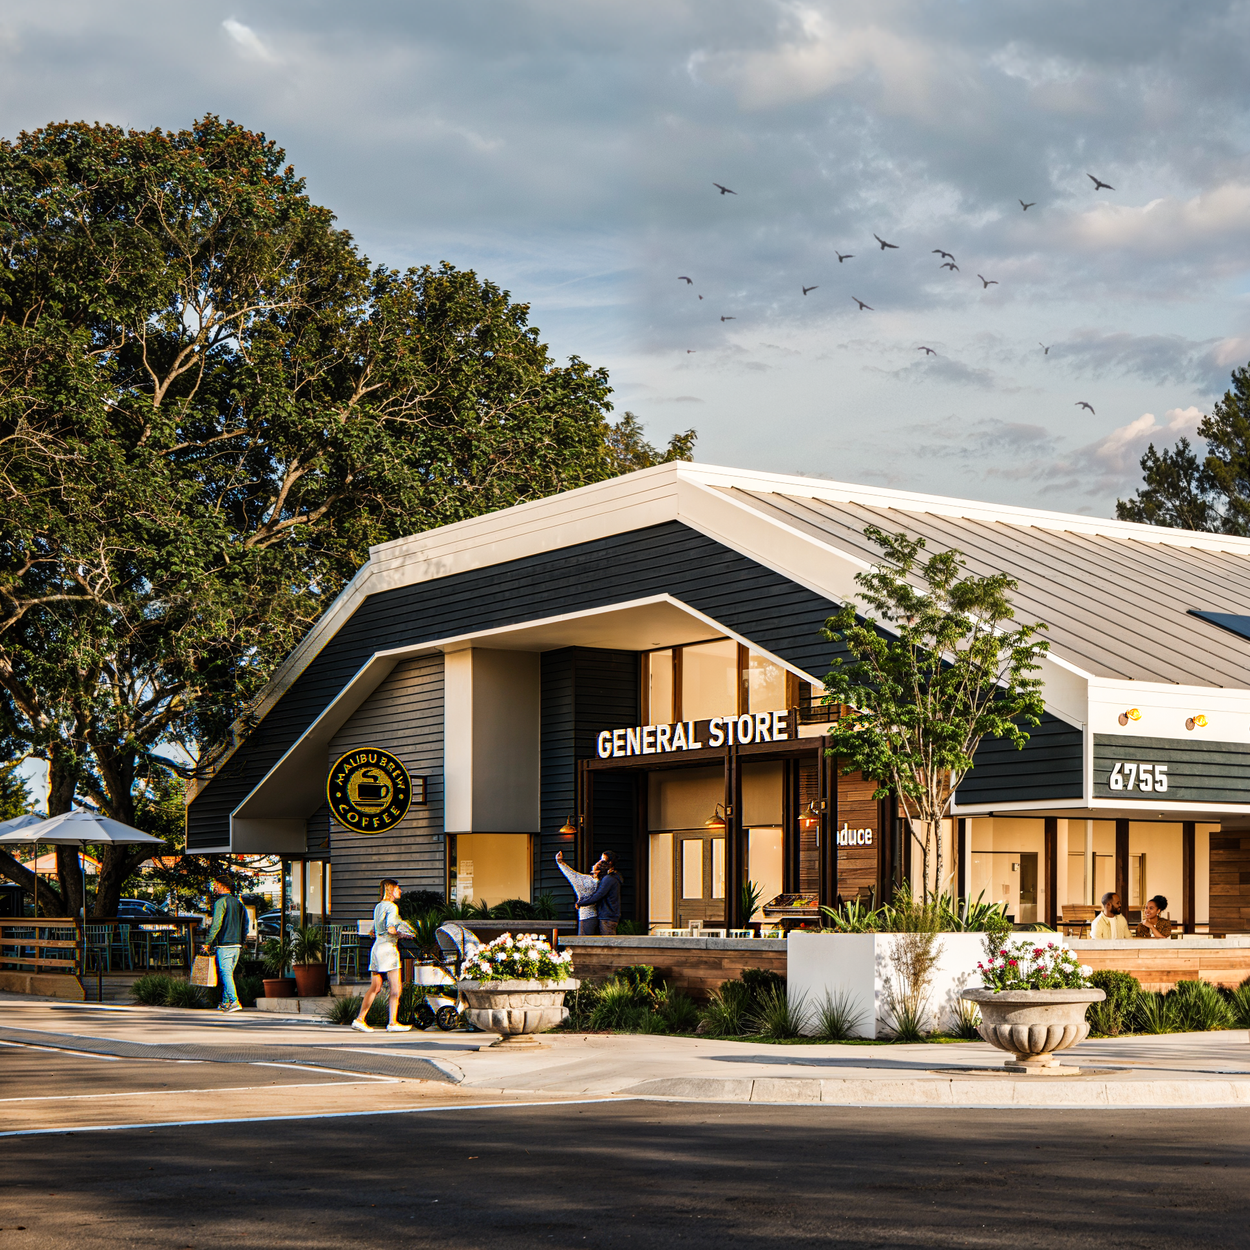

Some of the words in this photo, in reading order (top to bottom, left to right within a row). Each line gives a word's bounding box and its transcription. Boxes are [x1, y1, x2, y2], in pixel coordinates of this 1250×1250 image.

[597, 720, 702, 759] GENERAL
[708, 709, 789, 748] STORE
[334, 753, 378, 786] MALIBU
[379, 755, 406, 789] BREW
[1109, 762, 1168, 793] 6755
[338, 803, 401, 828] COFFEE
